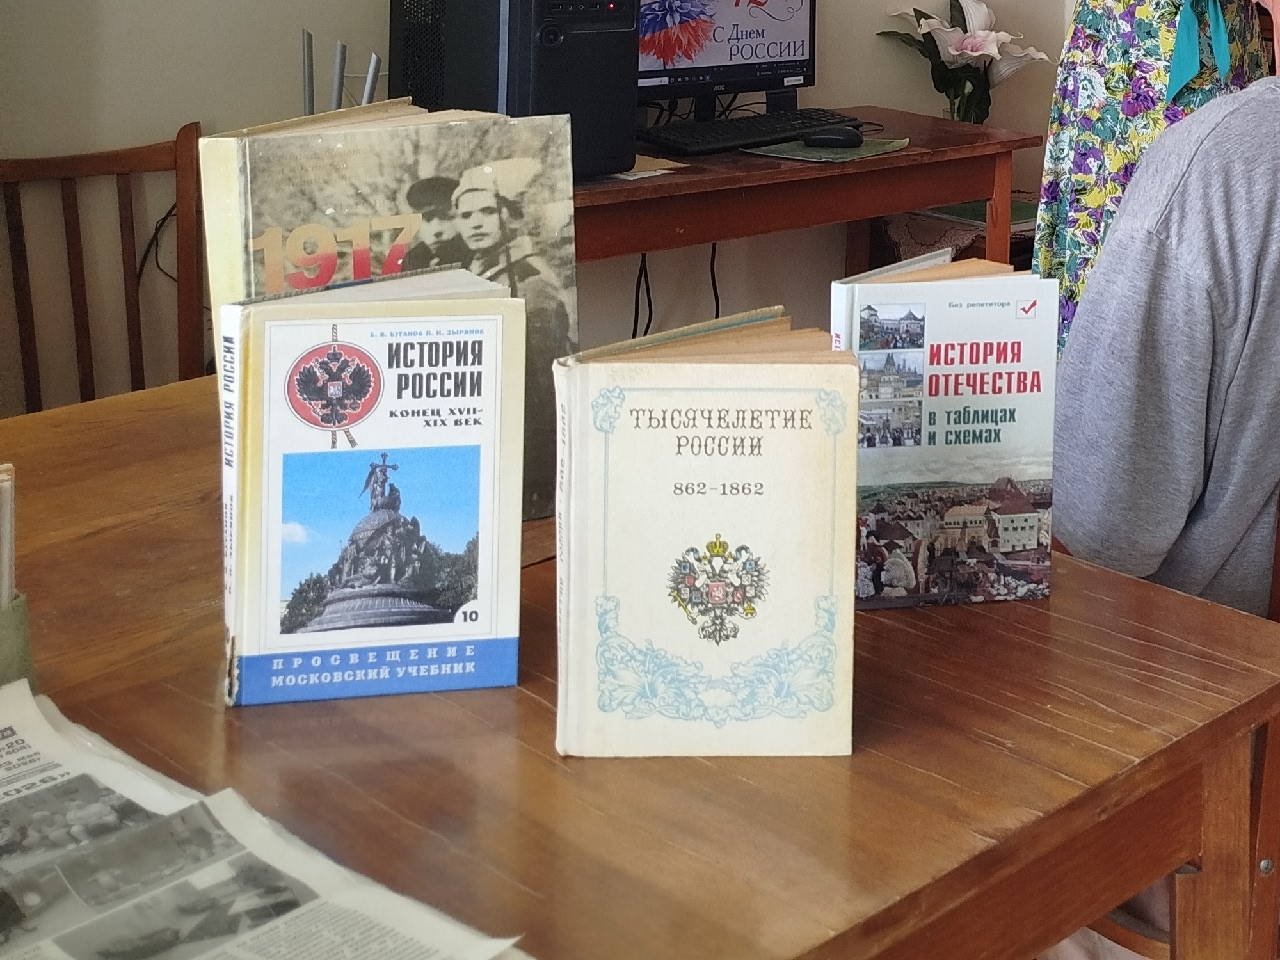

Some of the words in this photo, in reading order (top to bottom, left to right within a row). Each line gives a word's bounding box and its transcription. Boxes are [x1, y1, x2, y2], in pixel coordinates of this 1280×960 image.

[712, 26, 725, 43] С
[727, 23, 765, 44] Днем
[729, 40, 805, 61] РОССИИ
[253, 213, 422, 295] 1917
[966, 301, 1011, 309] репетитора
[222, 335, 235, 393] РОССИИ
[387, 340, 483, 369] ИСТОРИЯ
[929, 341, 1022, 366] ИСТОРИЯ
[396, 371, 482, 400] РОССИИ
[928, 371, 1042, 397] ОТЕЧЕСТВА
[389, 408, 442, 418] КОНЕЦ
[423, 418, 448, 428] XIX
[453, 417, 482, 427] ВЕК
[629, 408, 813, 431] ТЫСЯЧЕЛЕТИЕ
[928, 411, 937, 426] в
[945, 406, 1017, 427] таблицах
[223, 401, 235, 468] ИСТОРИЯ
[675, 435, 764, 457] РОССИИ
[928, 431, 937, 446] и
[945, 428, 1002, 446] схемах
[673, 482, 765, 496] 862-1862
[461, 609, 479, 623] 10
[272, 646, 476, 670] ПРОСВЕЩЕНИЕ
[271, 664, 390, 688] МОСКОВСКИЙ
[395, 660, 476, 680] УЧЕБНИК
[0, 771, 71, 800] 026»
